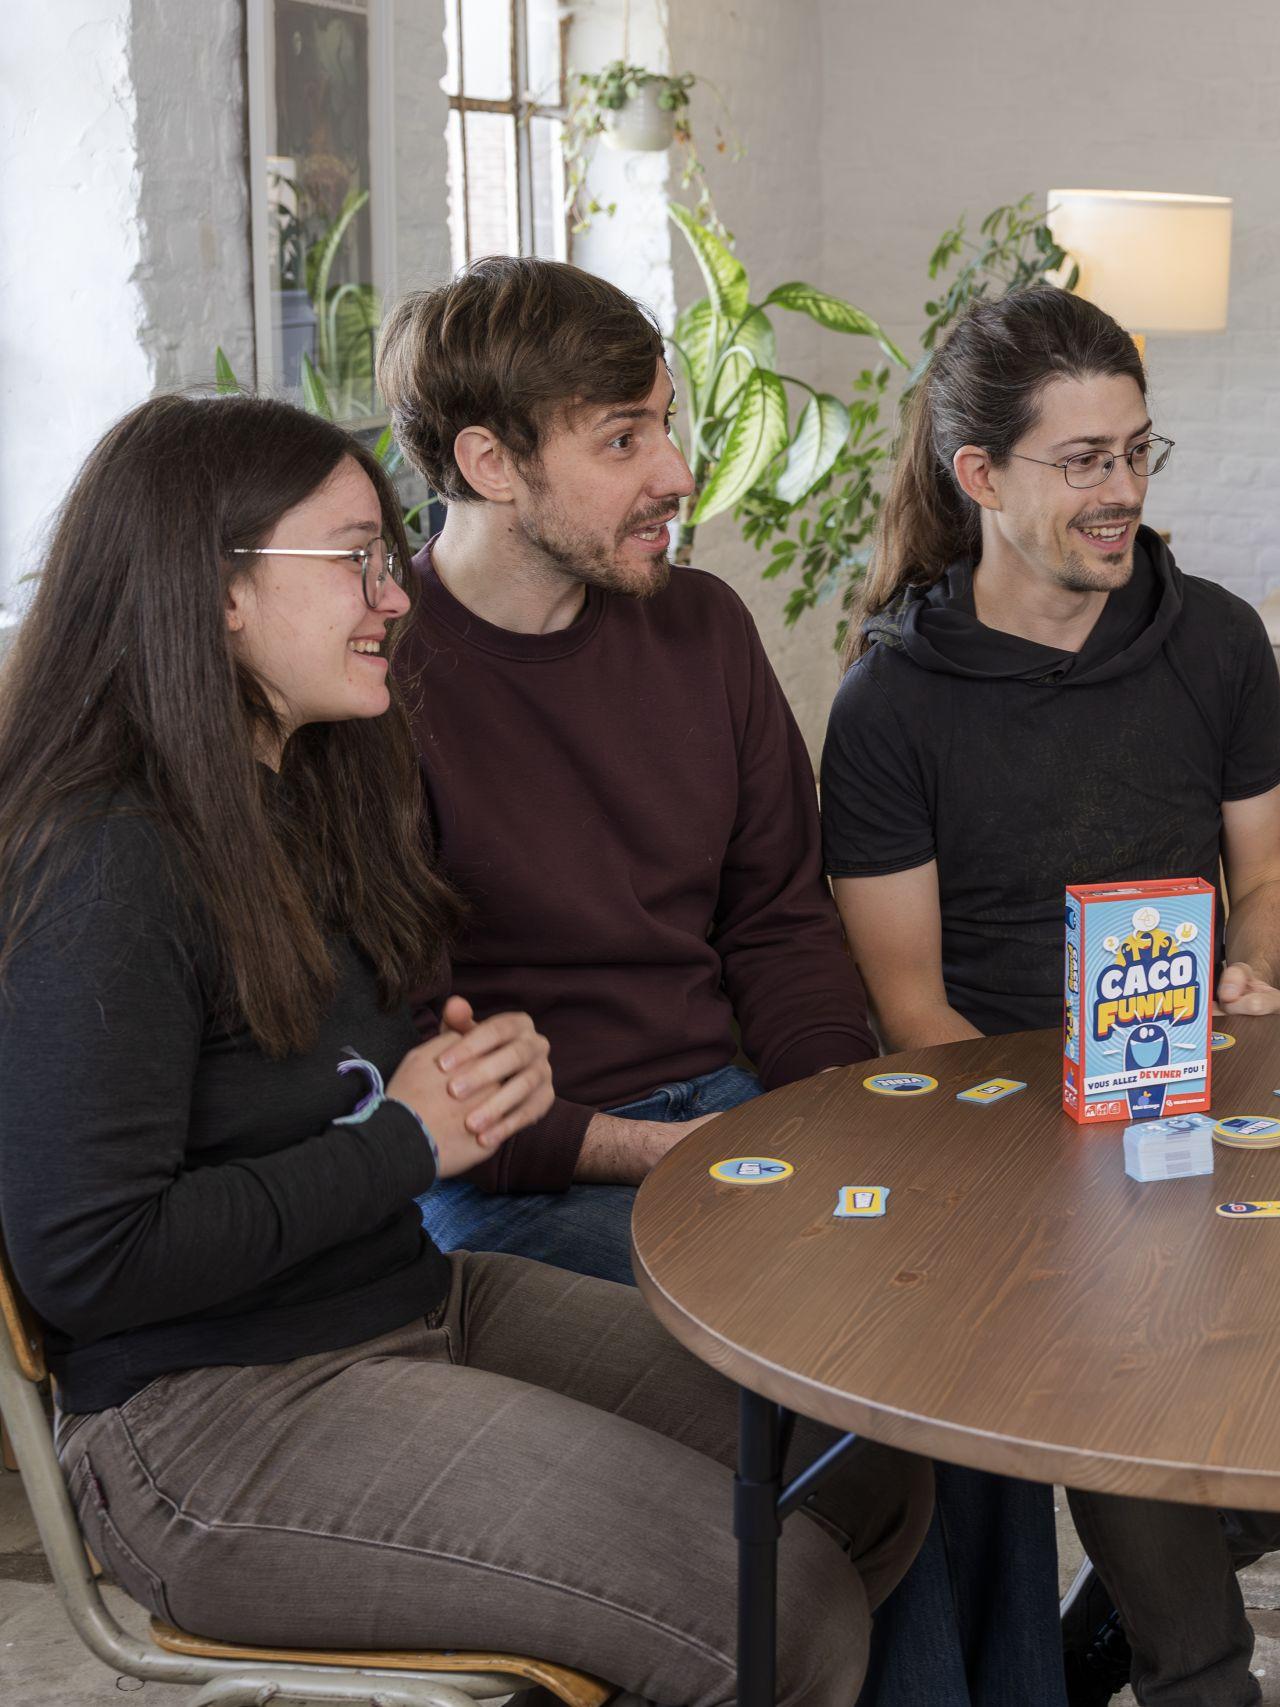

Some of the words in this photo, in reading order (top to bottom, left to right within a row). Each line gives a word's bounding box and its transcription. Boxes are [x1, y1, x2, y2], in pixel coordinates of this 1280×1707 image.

[1101, 955, 1193, 1000] CACO
[1097, 985, 1196, 1037] FUNNY
[1087, 1080, 1110, 1090] VOUS
[1112, 1075, 1138, 1086] ALLEZ
[1139, 1069, 1182, 1080] DEVINER
[1183, 1066, 1199, 1075] FOU
